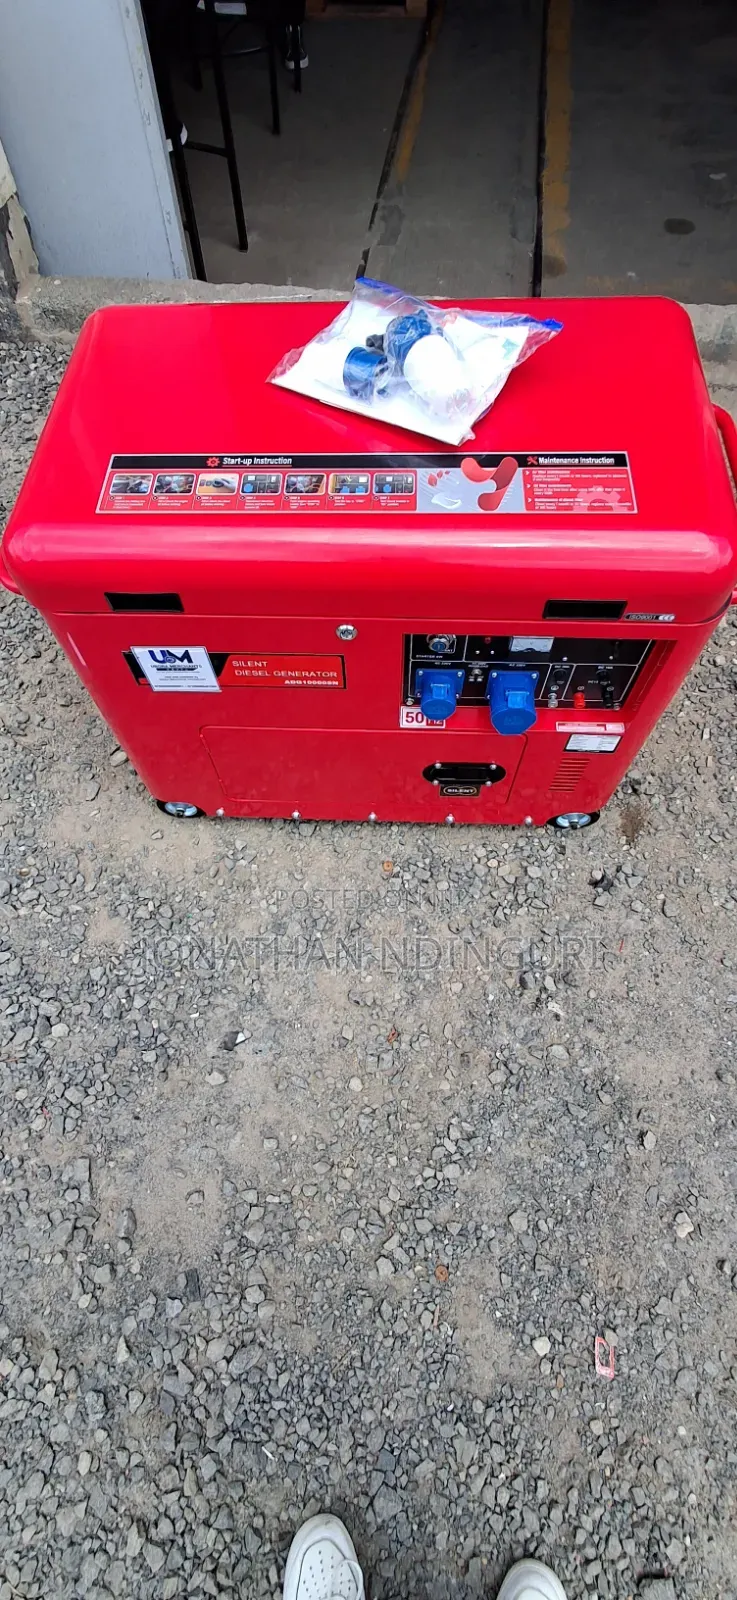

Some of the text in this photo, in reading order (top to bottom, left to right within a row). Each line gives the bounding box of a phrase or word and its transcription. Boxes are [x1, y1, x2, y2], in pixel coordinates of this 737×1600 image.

[222, 456, 293, 466] Start-up Instruction
[538, 456, 615, 464] Maintenance Instruction
[405, 711, 425, 724] 50
